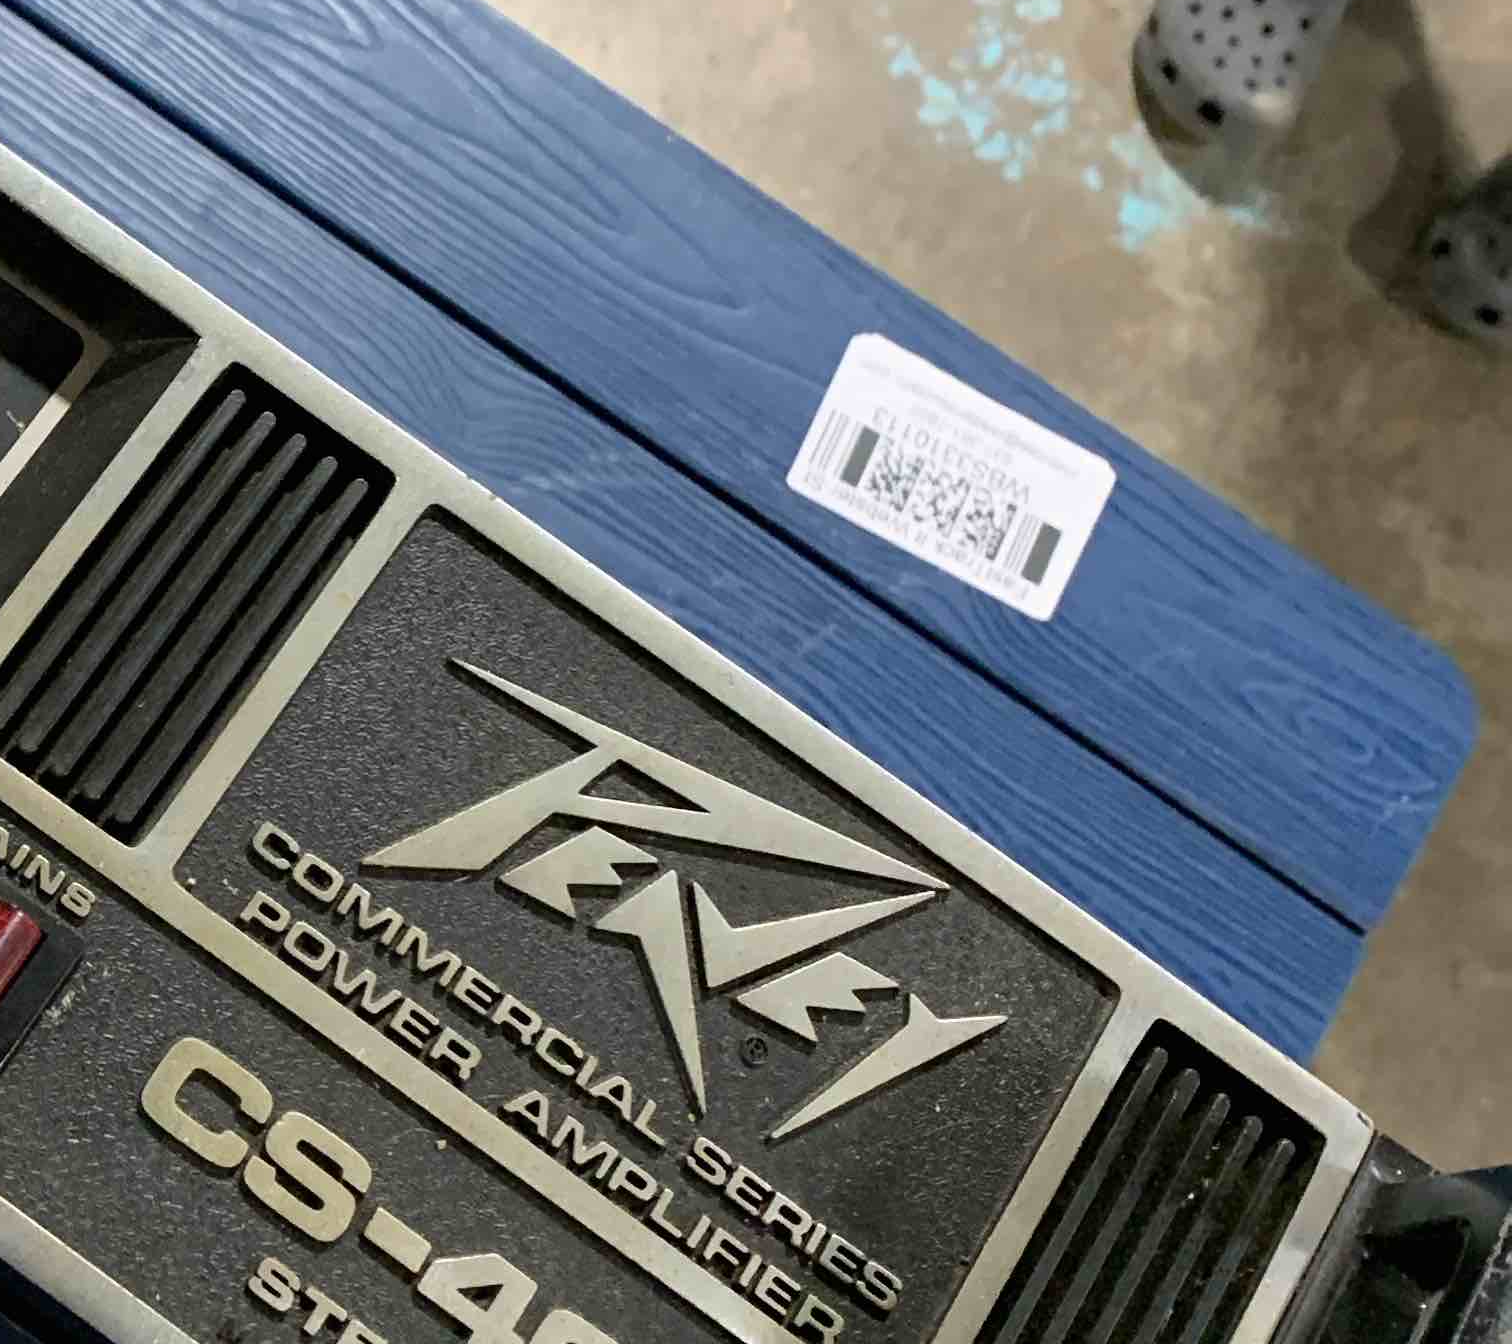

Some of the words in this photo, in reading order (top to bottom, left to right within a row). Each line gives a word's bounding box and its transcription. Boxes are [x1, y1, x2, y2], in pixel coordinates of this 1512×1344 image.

[240, 892, 483, 1083] POWER
[251, 821, 667, 1150] COMMERCIAL
[687, 1136, 903, 1310] SERIES
